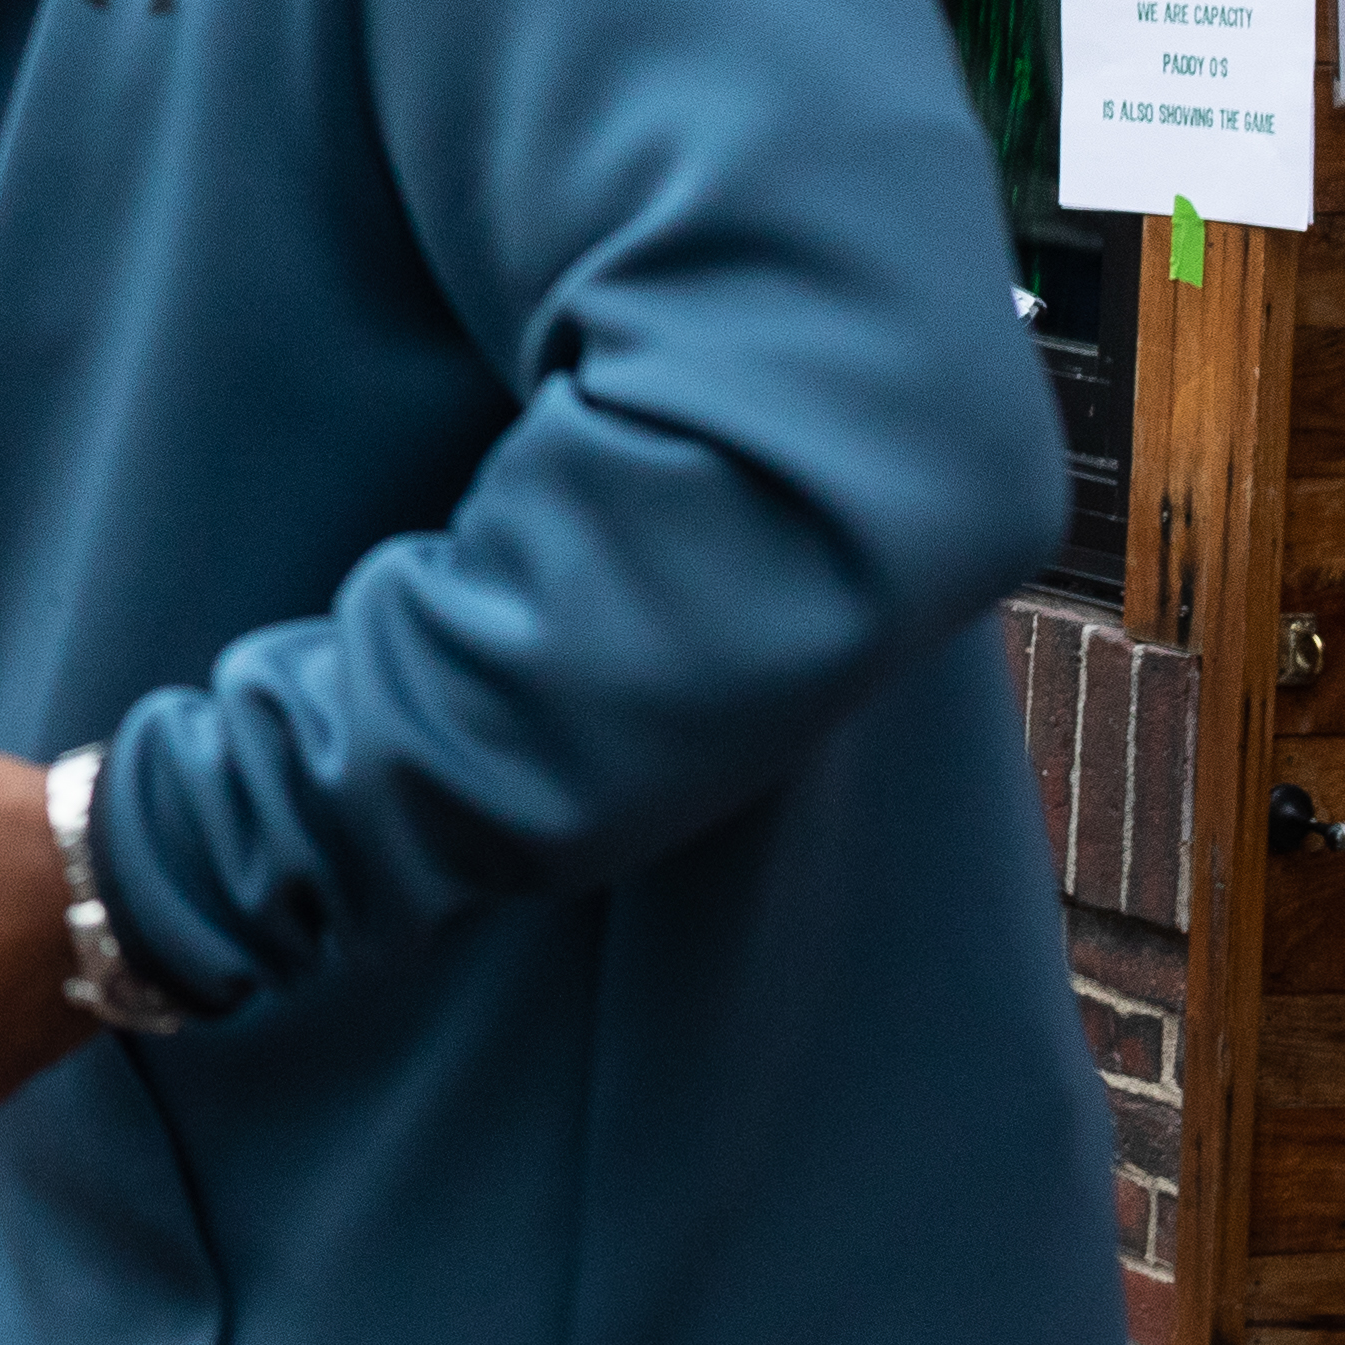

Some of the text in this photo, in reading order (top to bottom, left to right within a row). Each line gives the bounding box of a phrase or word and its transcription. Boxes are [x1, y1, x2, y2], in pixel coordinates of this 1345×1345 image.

[1136, 1, 1254, 29] WE ARE CAPACITY
[1162, 52, 1206, 77] PADDY
[1102, 99, 1276, 136] IS ALSO SHOWING THE GAME
